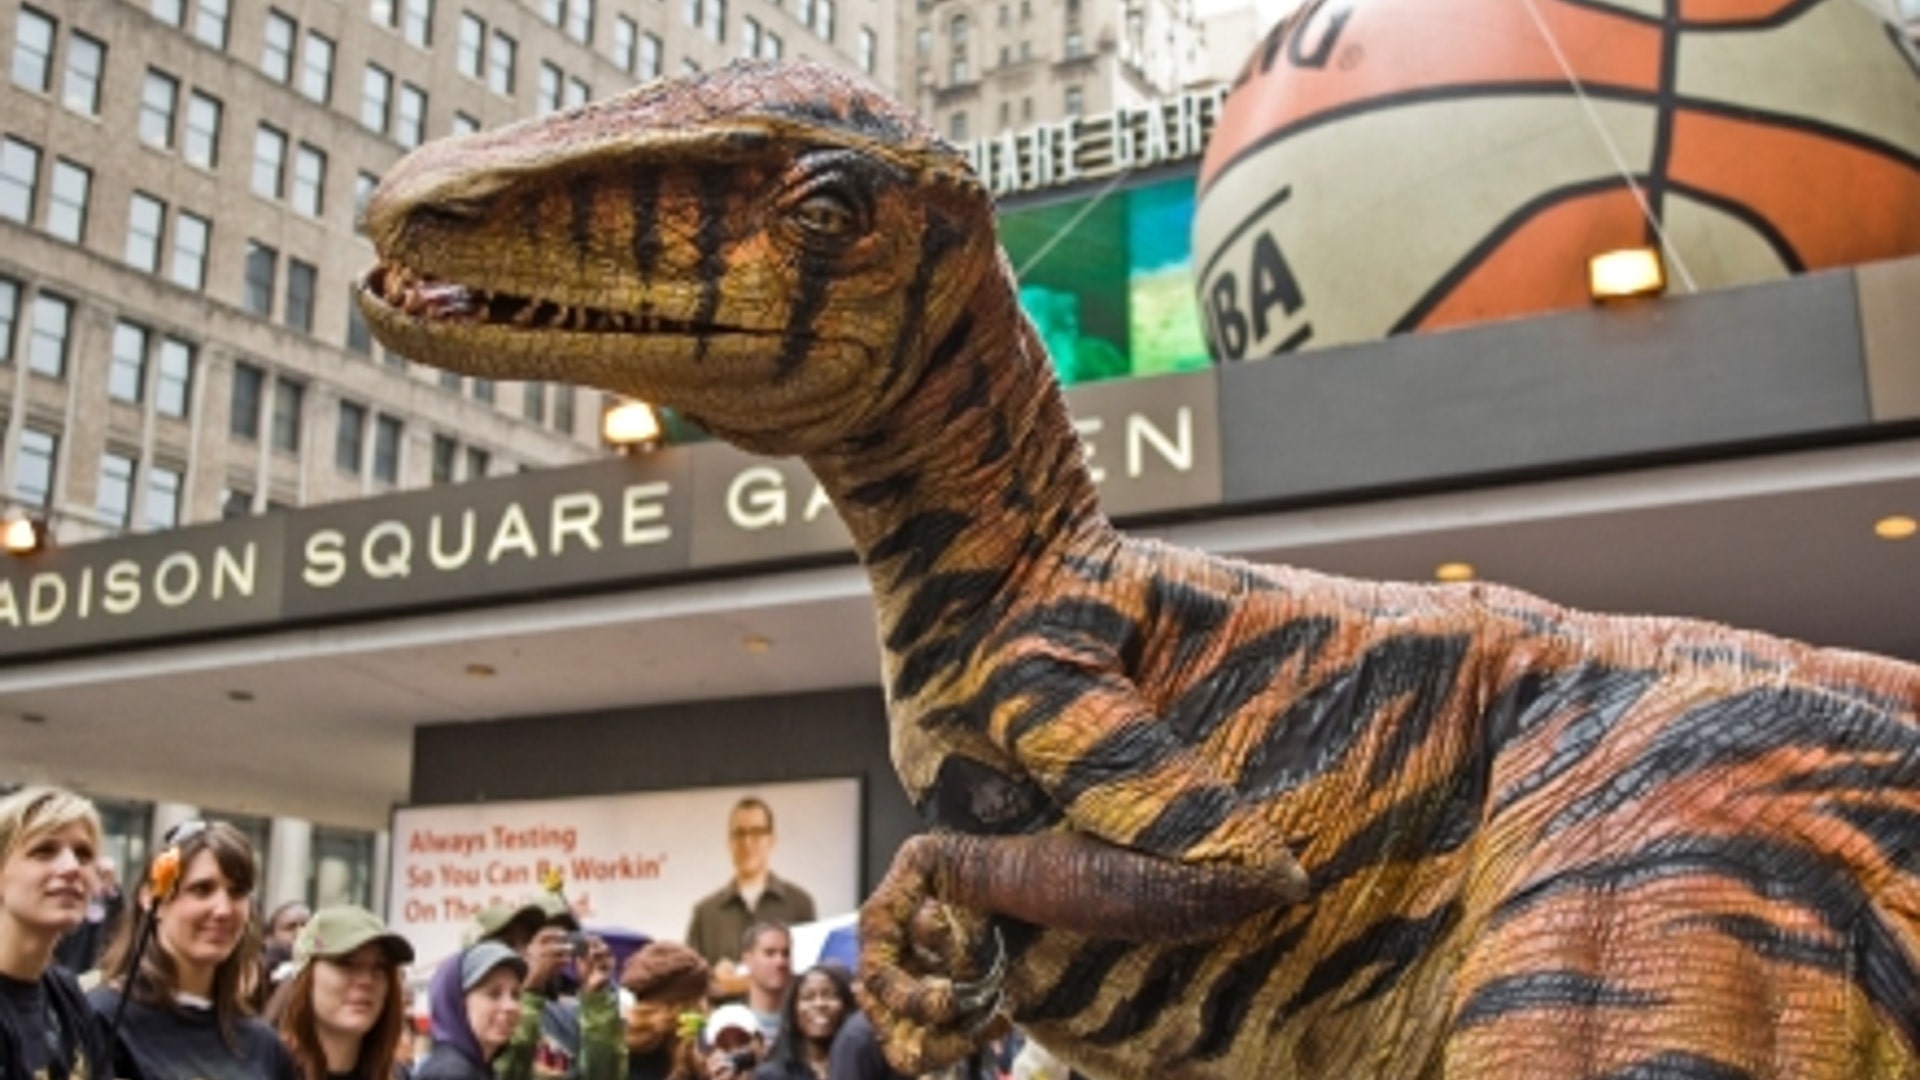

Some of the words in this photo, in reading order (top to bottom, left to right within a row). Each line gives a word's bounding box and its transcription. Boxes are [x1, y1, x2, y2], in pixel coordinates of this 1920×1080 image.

[1204, 228, 1305, 363] BA
[302, 482, 672, 588] SQUARE
[408, 829, 486, 855] Always
[493, 825, 577, 853] Testing
[406, 865, 434, 887] So
[440, 863, 480, 886] You
[485, 861, 529, 885] Can
[536, 859, 565, 884] B
[404, 899, 437, 922] On
